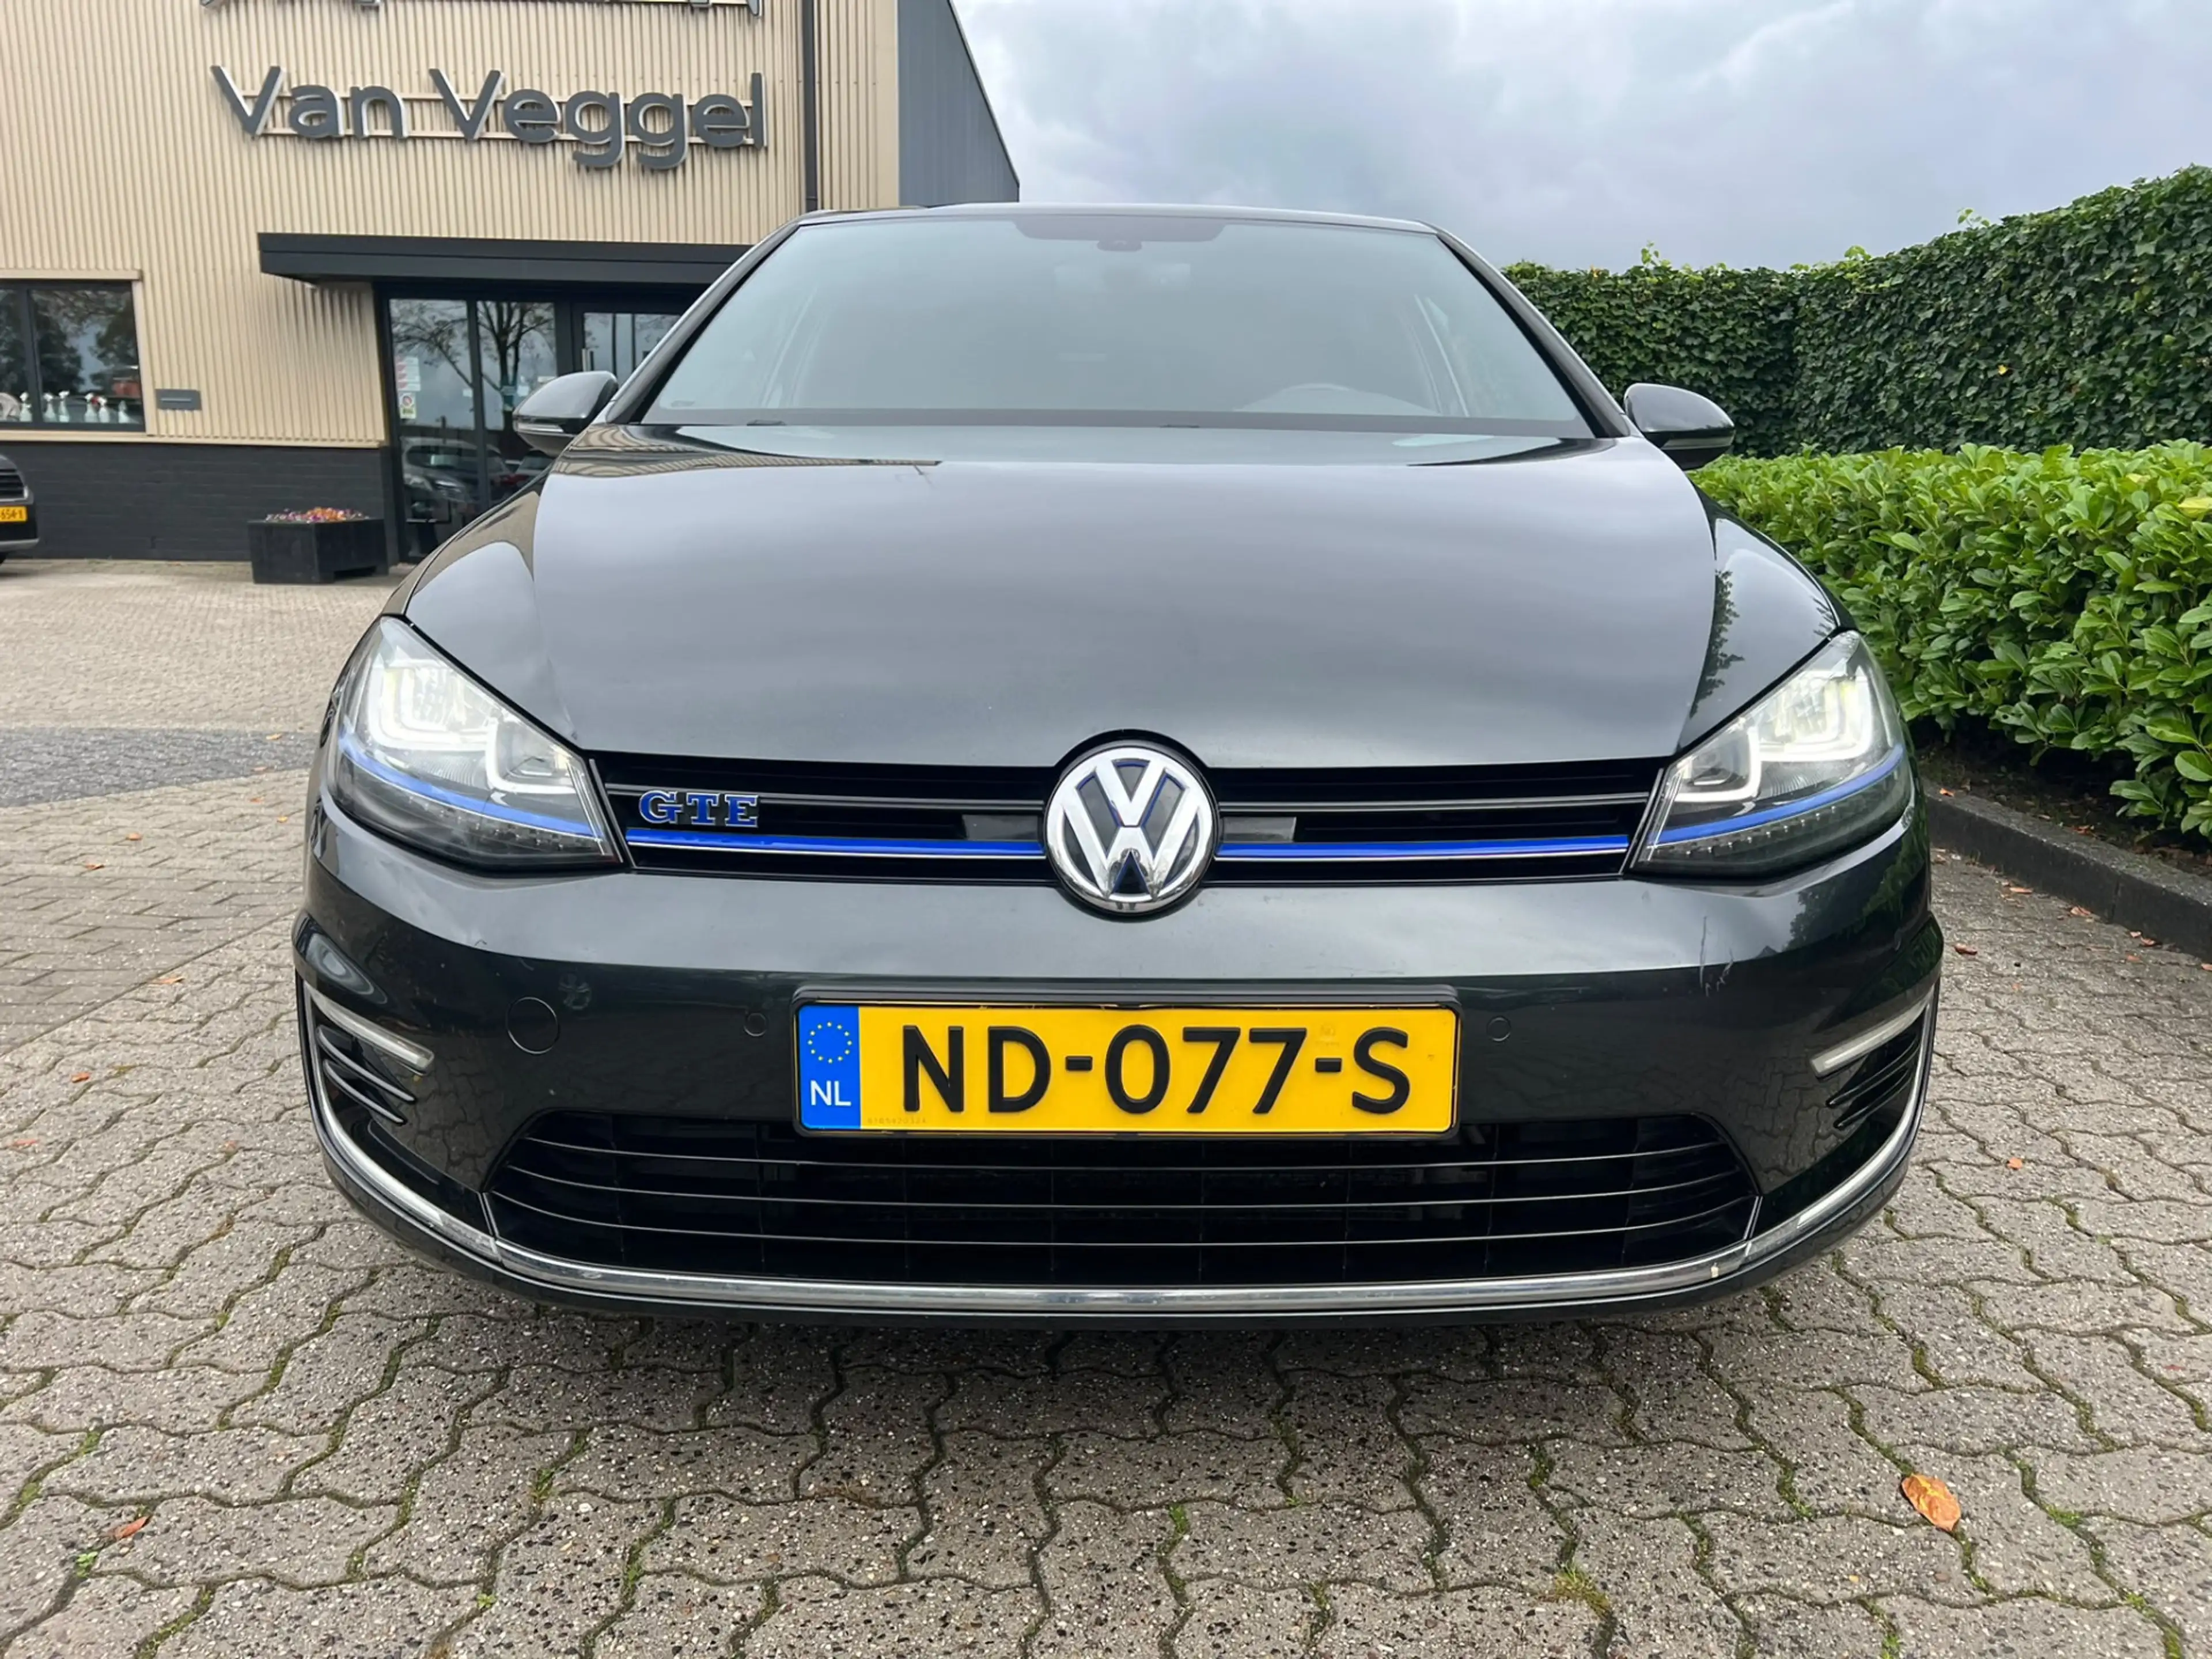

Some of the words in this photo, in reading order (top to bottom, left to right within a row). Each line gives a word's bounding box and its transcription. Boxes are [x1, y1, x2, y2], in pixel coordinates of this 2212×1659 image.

[211, 65, 408, 141] Van
[429, 69, 767, 170] Veggel
[639, 790, 759, 828] GTE
[1052, 750, 1209, 908] VW
[810, 1080, 851, 1106] NL
[902, 1024, 1410, 1115] ND-077-S
